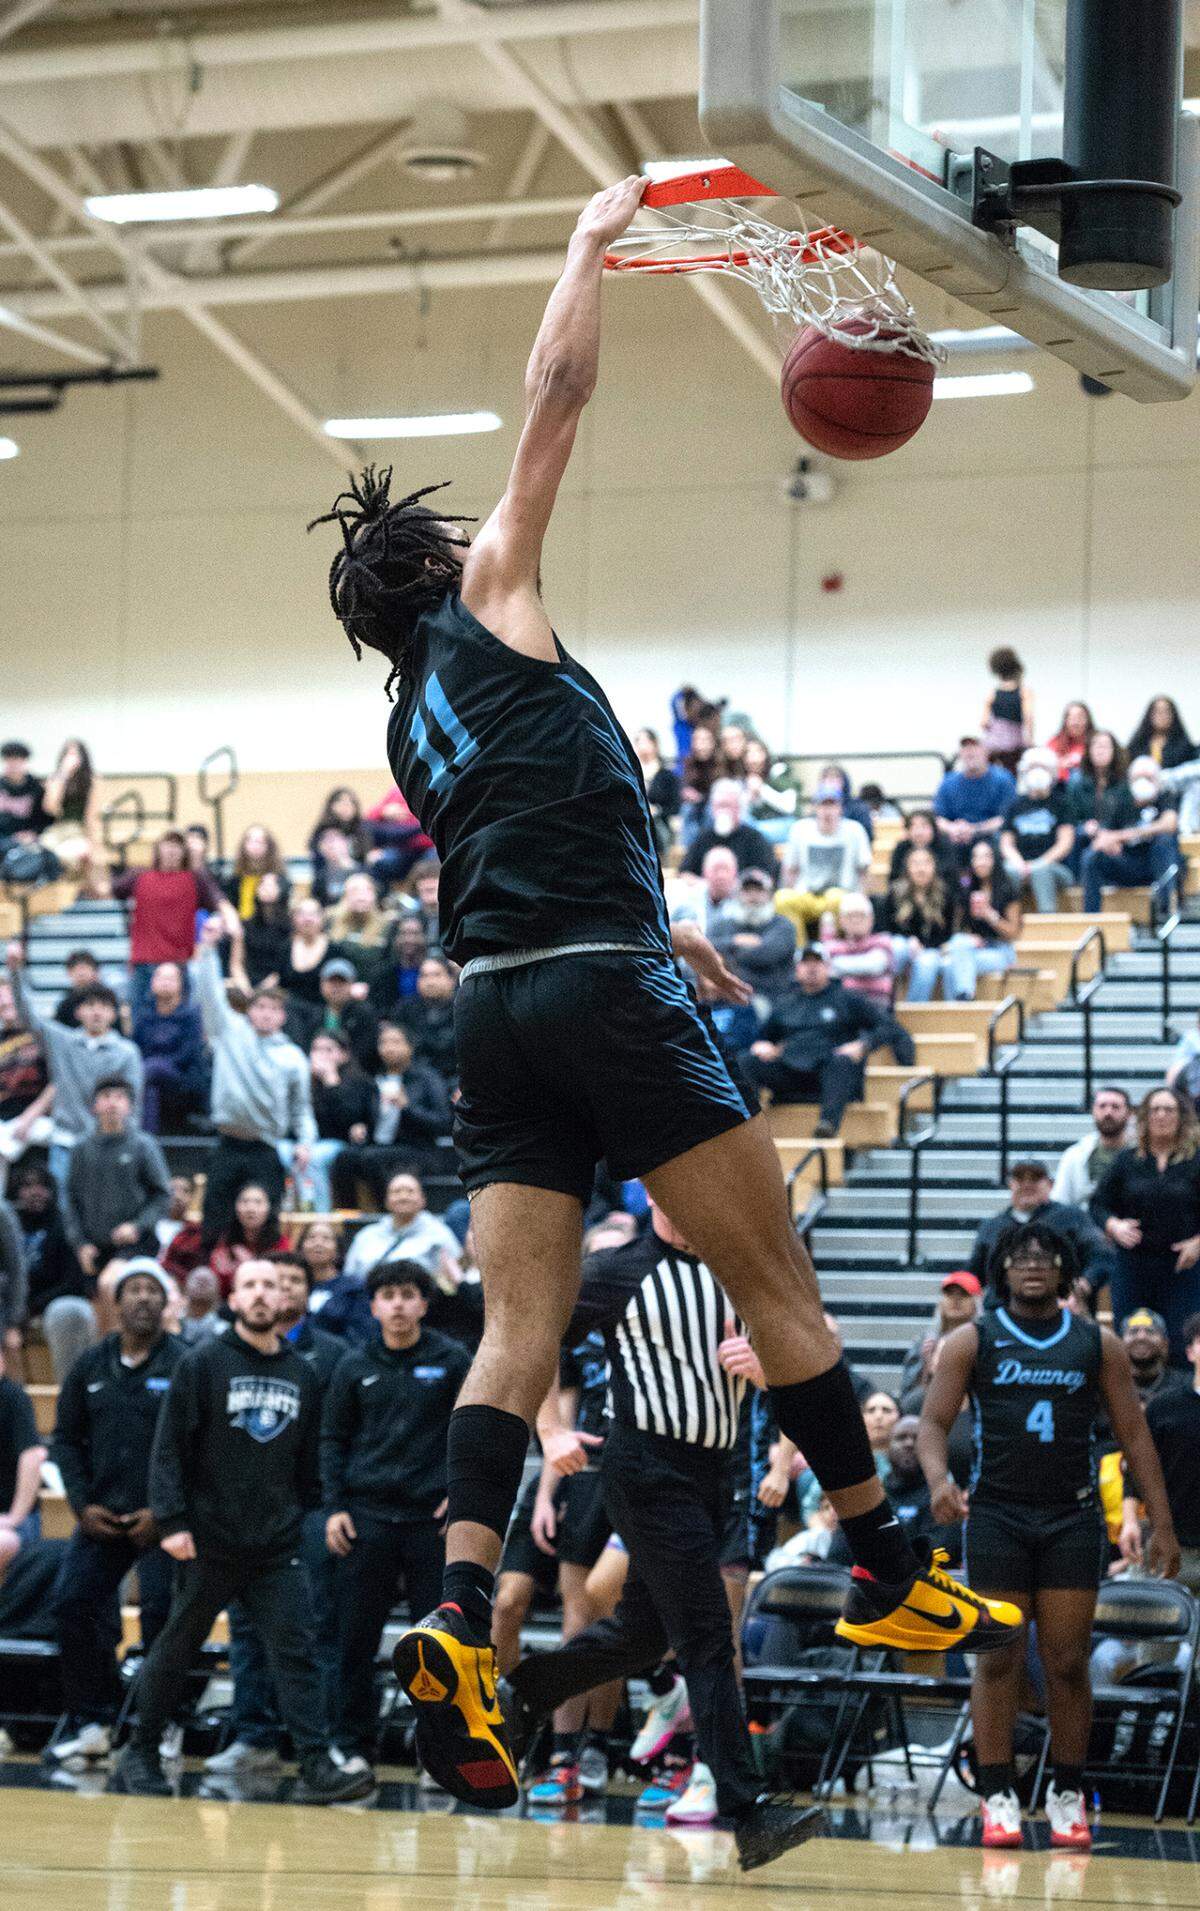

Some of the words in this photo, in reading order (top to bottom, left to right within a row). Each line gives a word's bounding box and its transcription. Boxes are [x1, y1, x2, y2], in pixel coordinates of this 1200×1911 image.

[409, 670, 481, 797] 11
[992, 1358, 1086, 1394] Downey
[1026, 1399, 1055, 1443] 4
